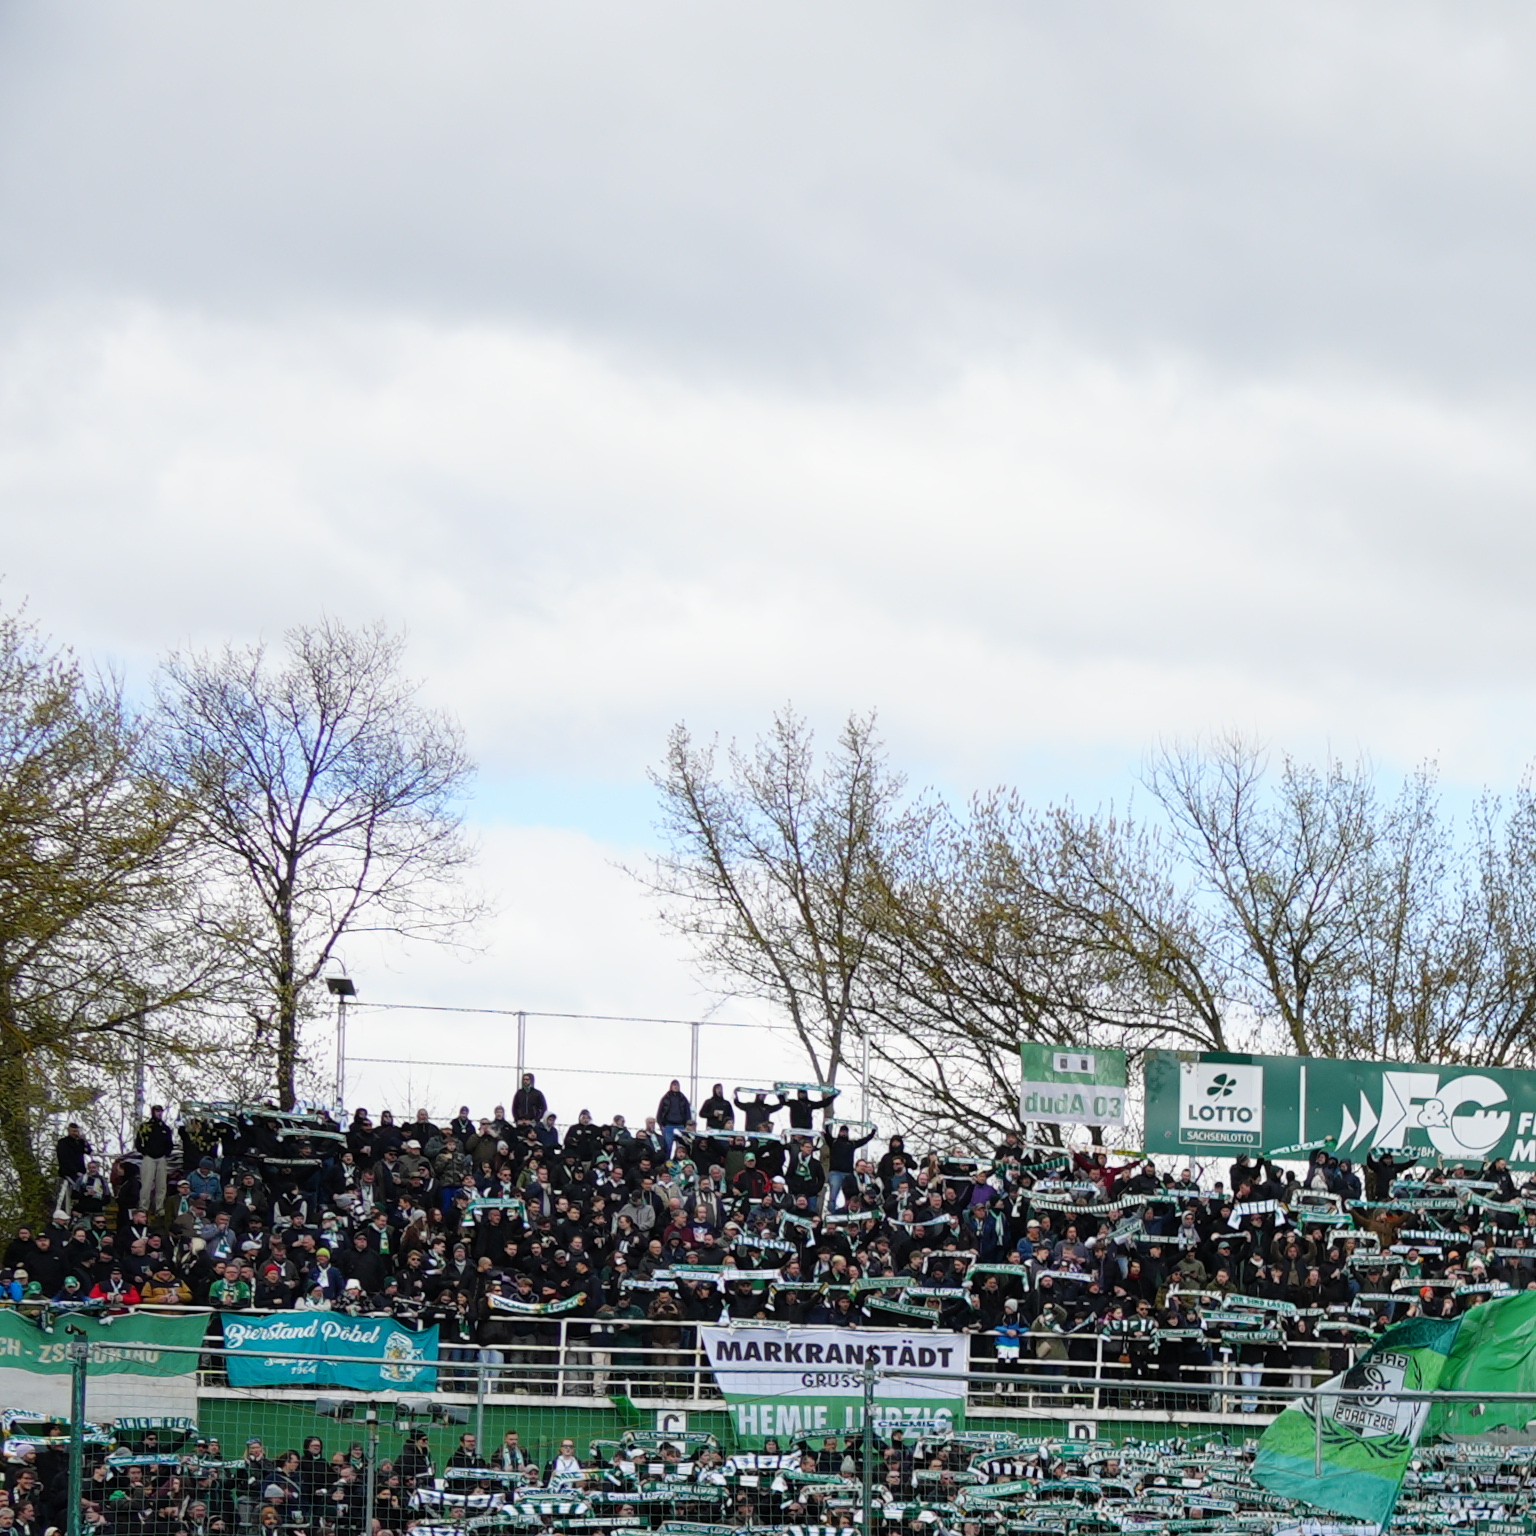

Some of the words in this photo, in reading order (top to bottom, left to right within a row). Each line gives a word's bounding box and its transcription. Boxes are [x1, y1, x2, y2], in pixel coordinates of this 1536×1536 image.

[1093, 1096, 1122, 1118] 03
[1188, 1103, 1254, 1123] LOTTO
[1187, 1130, 1254, 1144] SACHSENLOTTO
[225, 1318, 320, 1349] Bierstand
[321, 1319, 383, 1345] Pöbel
[715, 1340, 954, 1369] MARKRANSTÄDT
[732, 1404, 827, 1436] HEMIE
